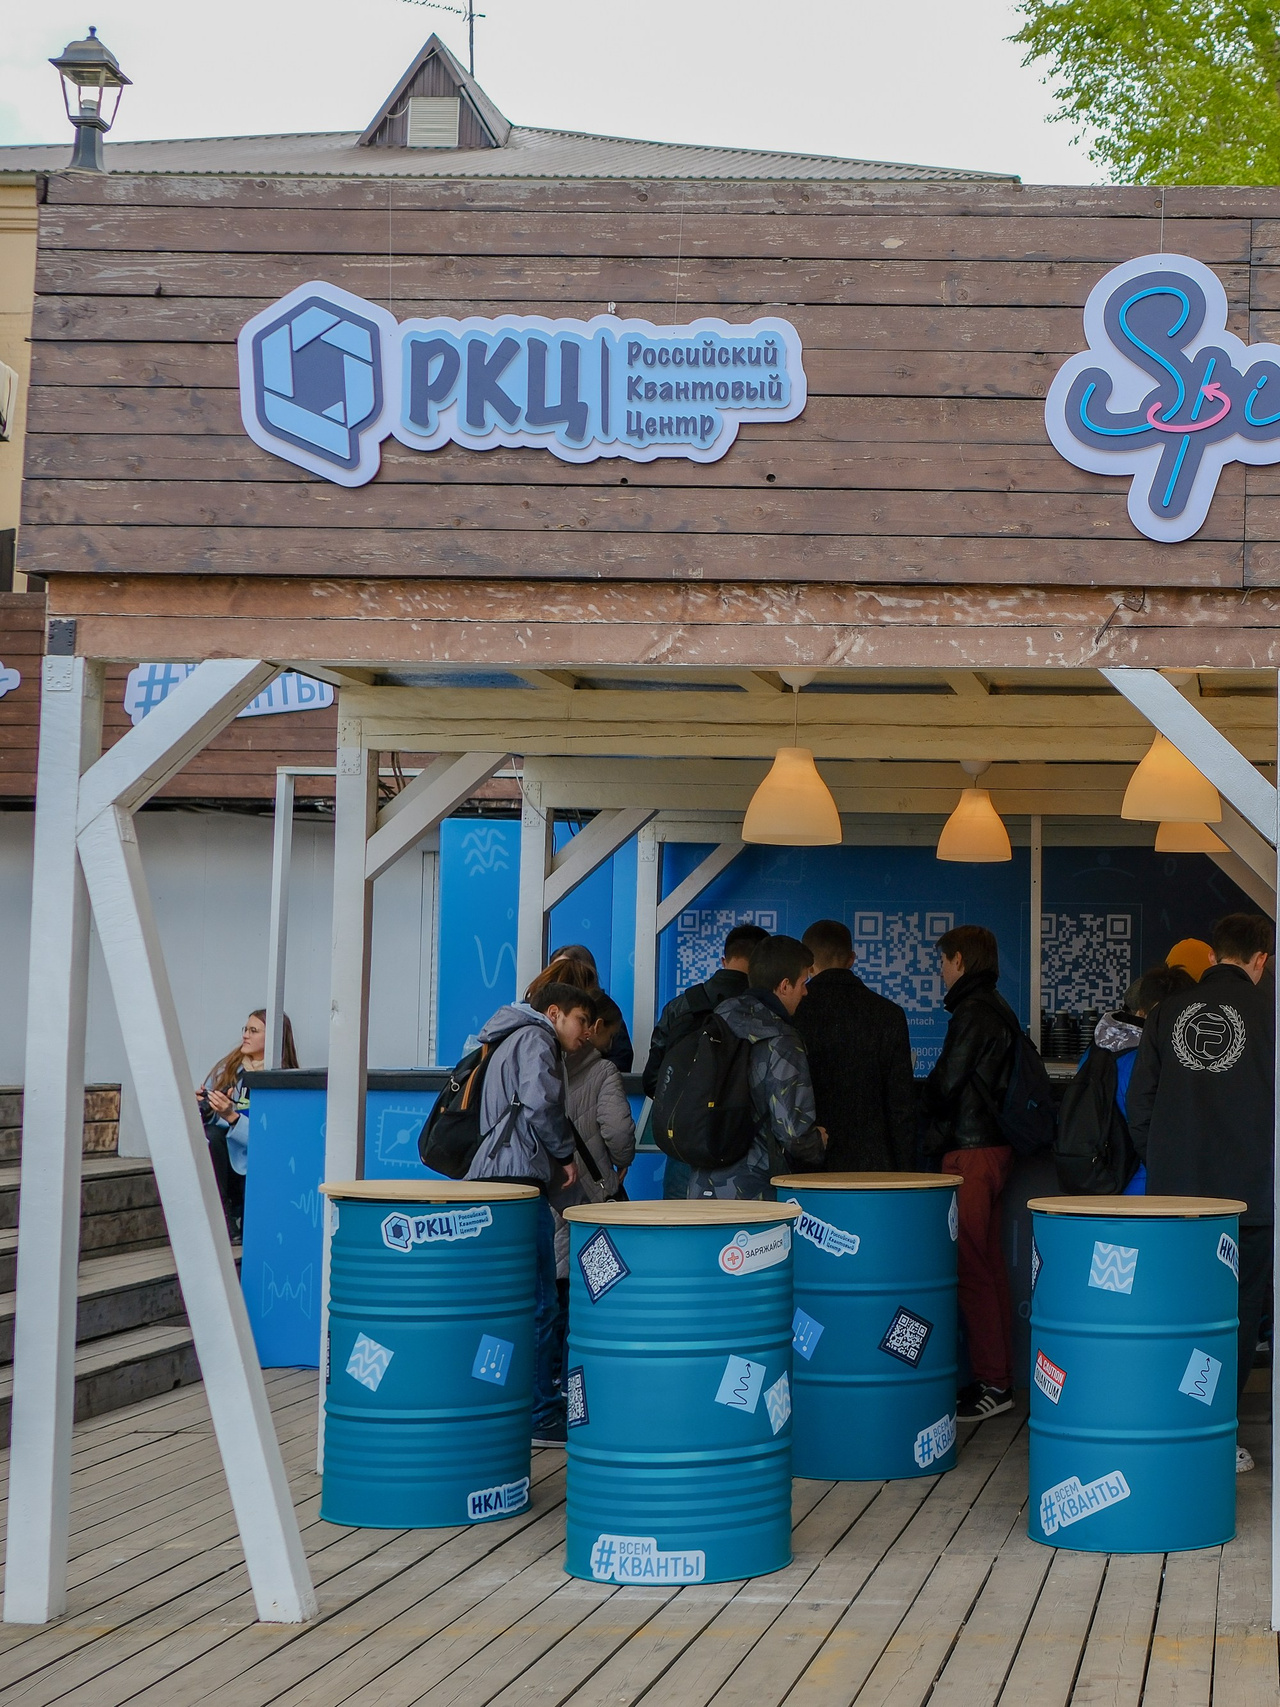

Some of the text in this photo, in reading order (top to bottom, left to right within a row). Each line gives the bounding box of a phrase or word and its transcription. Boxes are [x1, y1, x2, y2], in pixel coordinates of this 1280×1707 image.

[626, 339, 778, 369] Российский
[408, 336, 591, 441] РКЦ
[626, 371, 783, 402] Квантовый
[625, 408, 717, 440] Центр
[414, 1217, 453, 1239] РКЦ
[799, 1215, 825, 1244] РКЦ
[745, 1238, 783, 1258] ЗАРЯЖАЙСЯ
[471, 1491, 503, 1515] НКЛ
[1058, 1476, 1125, 1522] КВАНТЫ
[618, 1556, 700, 1577] КВАНТЫ
